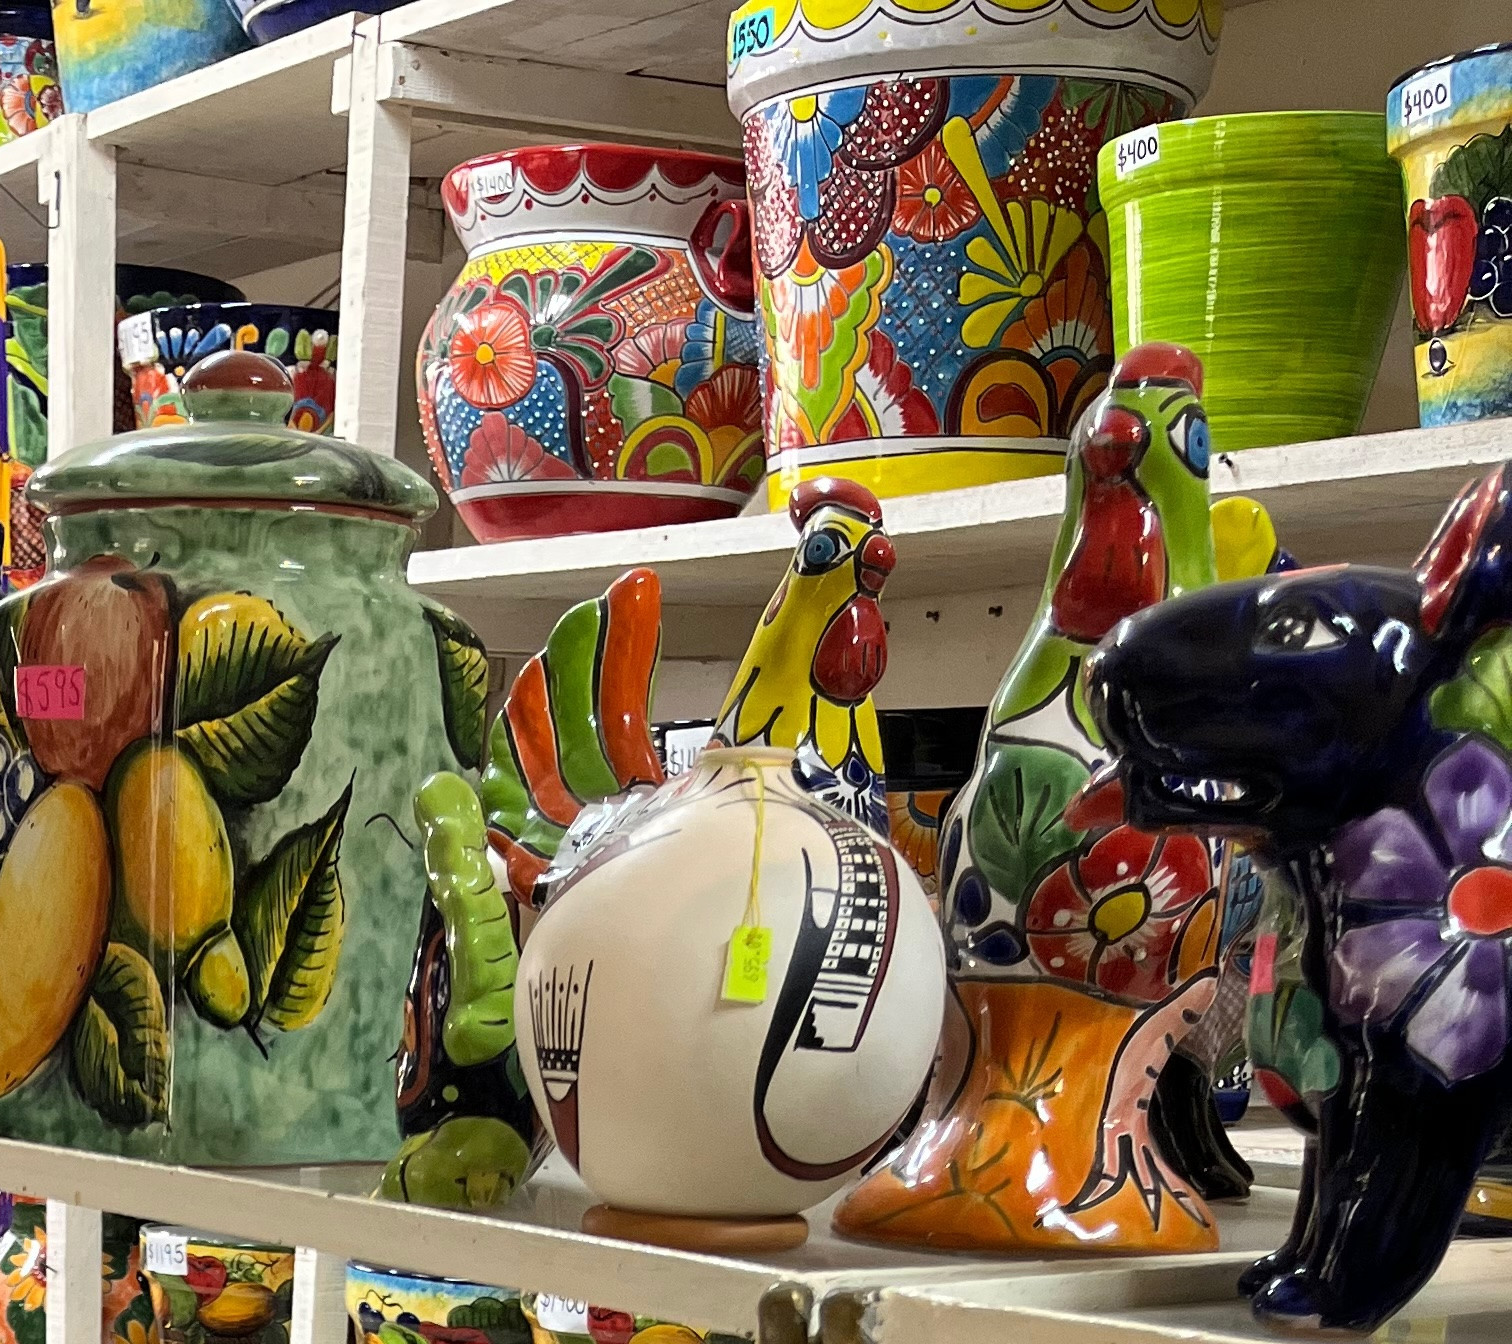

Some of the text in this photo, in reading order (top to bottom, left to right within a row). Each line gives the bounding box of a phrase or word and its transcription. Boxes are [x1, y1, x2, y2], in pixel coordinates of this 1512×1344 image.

[732, 15, 770, 60] 1550
[1404, 89, 1447, 126] $400
[1117, 143, 1158, 172] $400
[475, 172, 514, 197] $1400
[18, 668, 84, 717] $595
[148, 1243, 184, 1265] $1195
